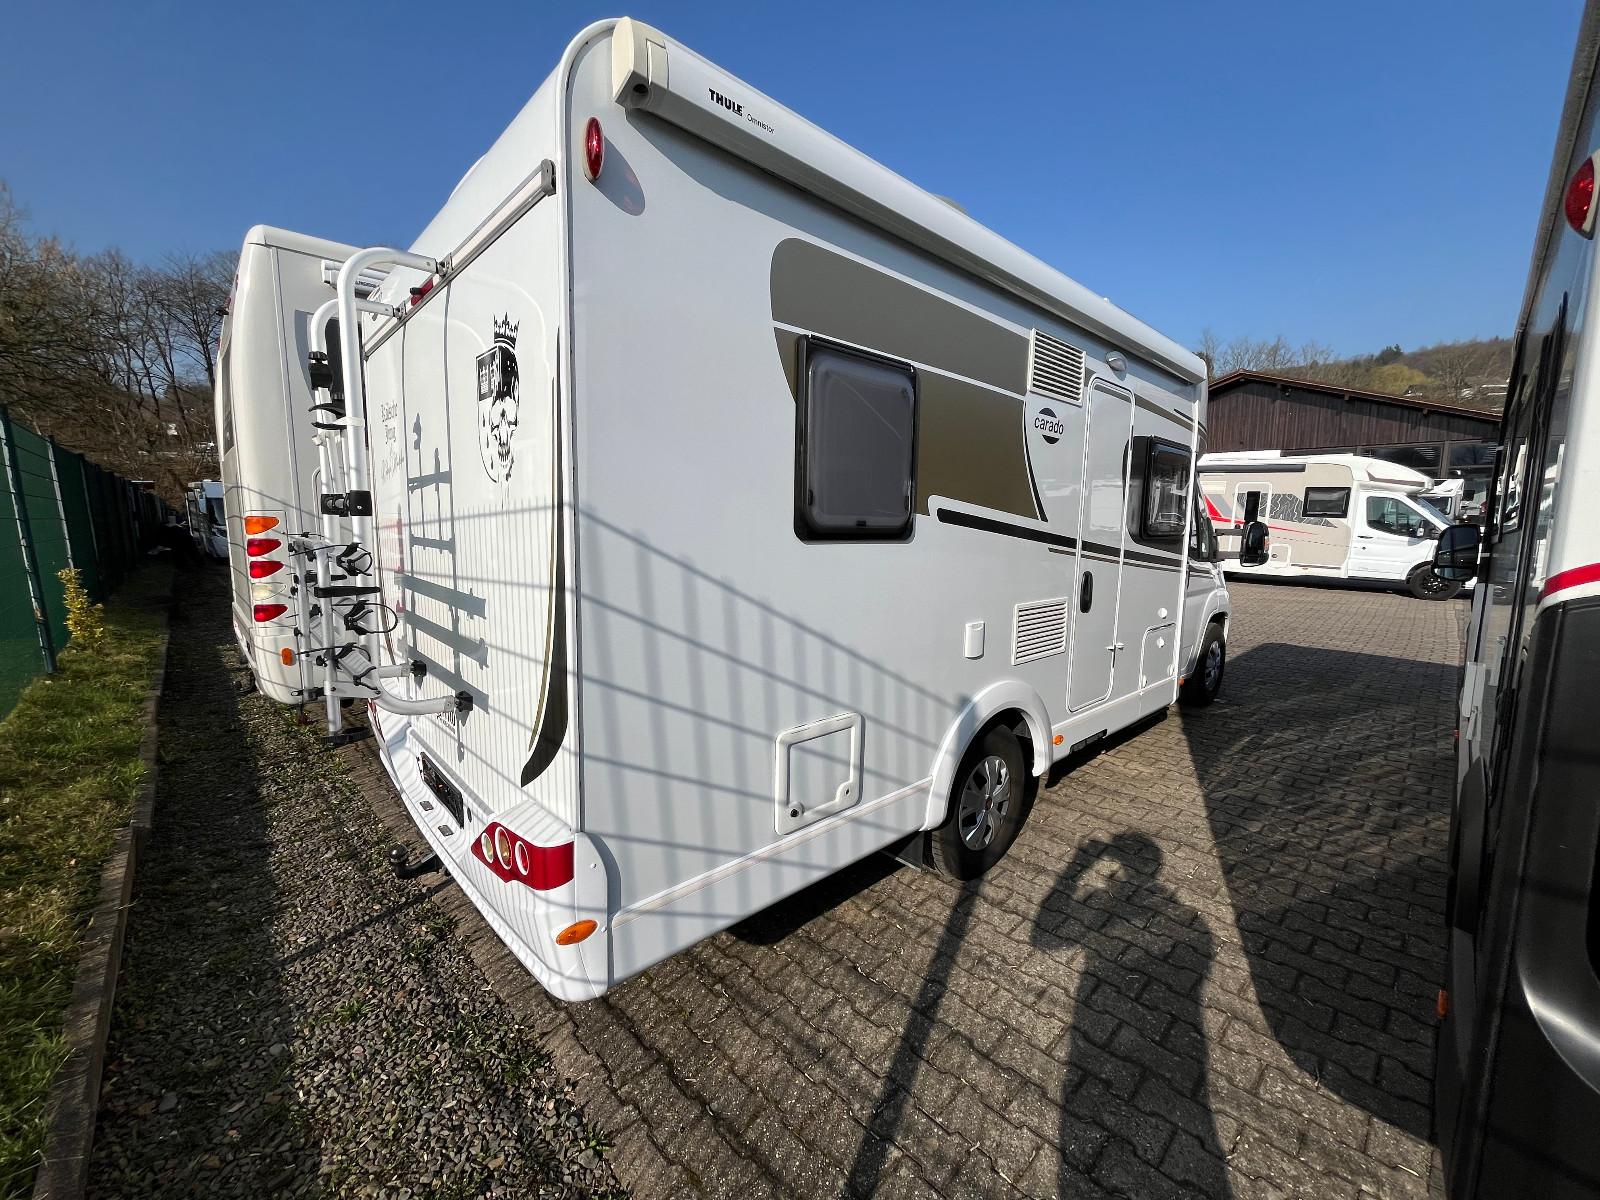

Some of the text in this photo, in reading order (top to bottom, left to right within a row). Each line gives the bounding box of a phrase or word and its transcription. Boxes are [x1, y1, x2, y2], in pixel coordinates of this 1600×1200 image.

[708, 88, 775, 134] THULE Omnistor
[1034, 417, 1064, 435] carado
